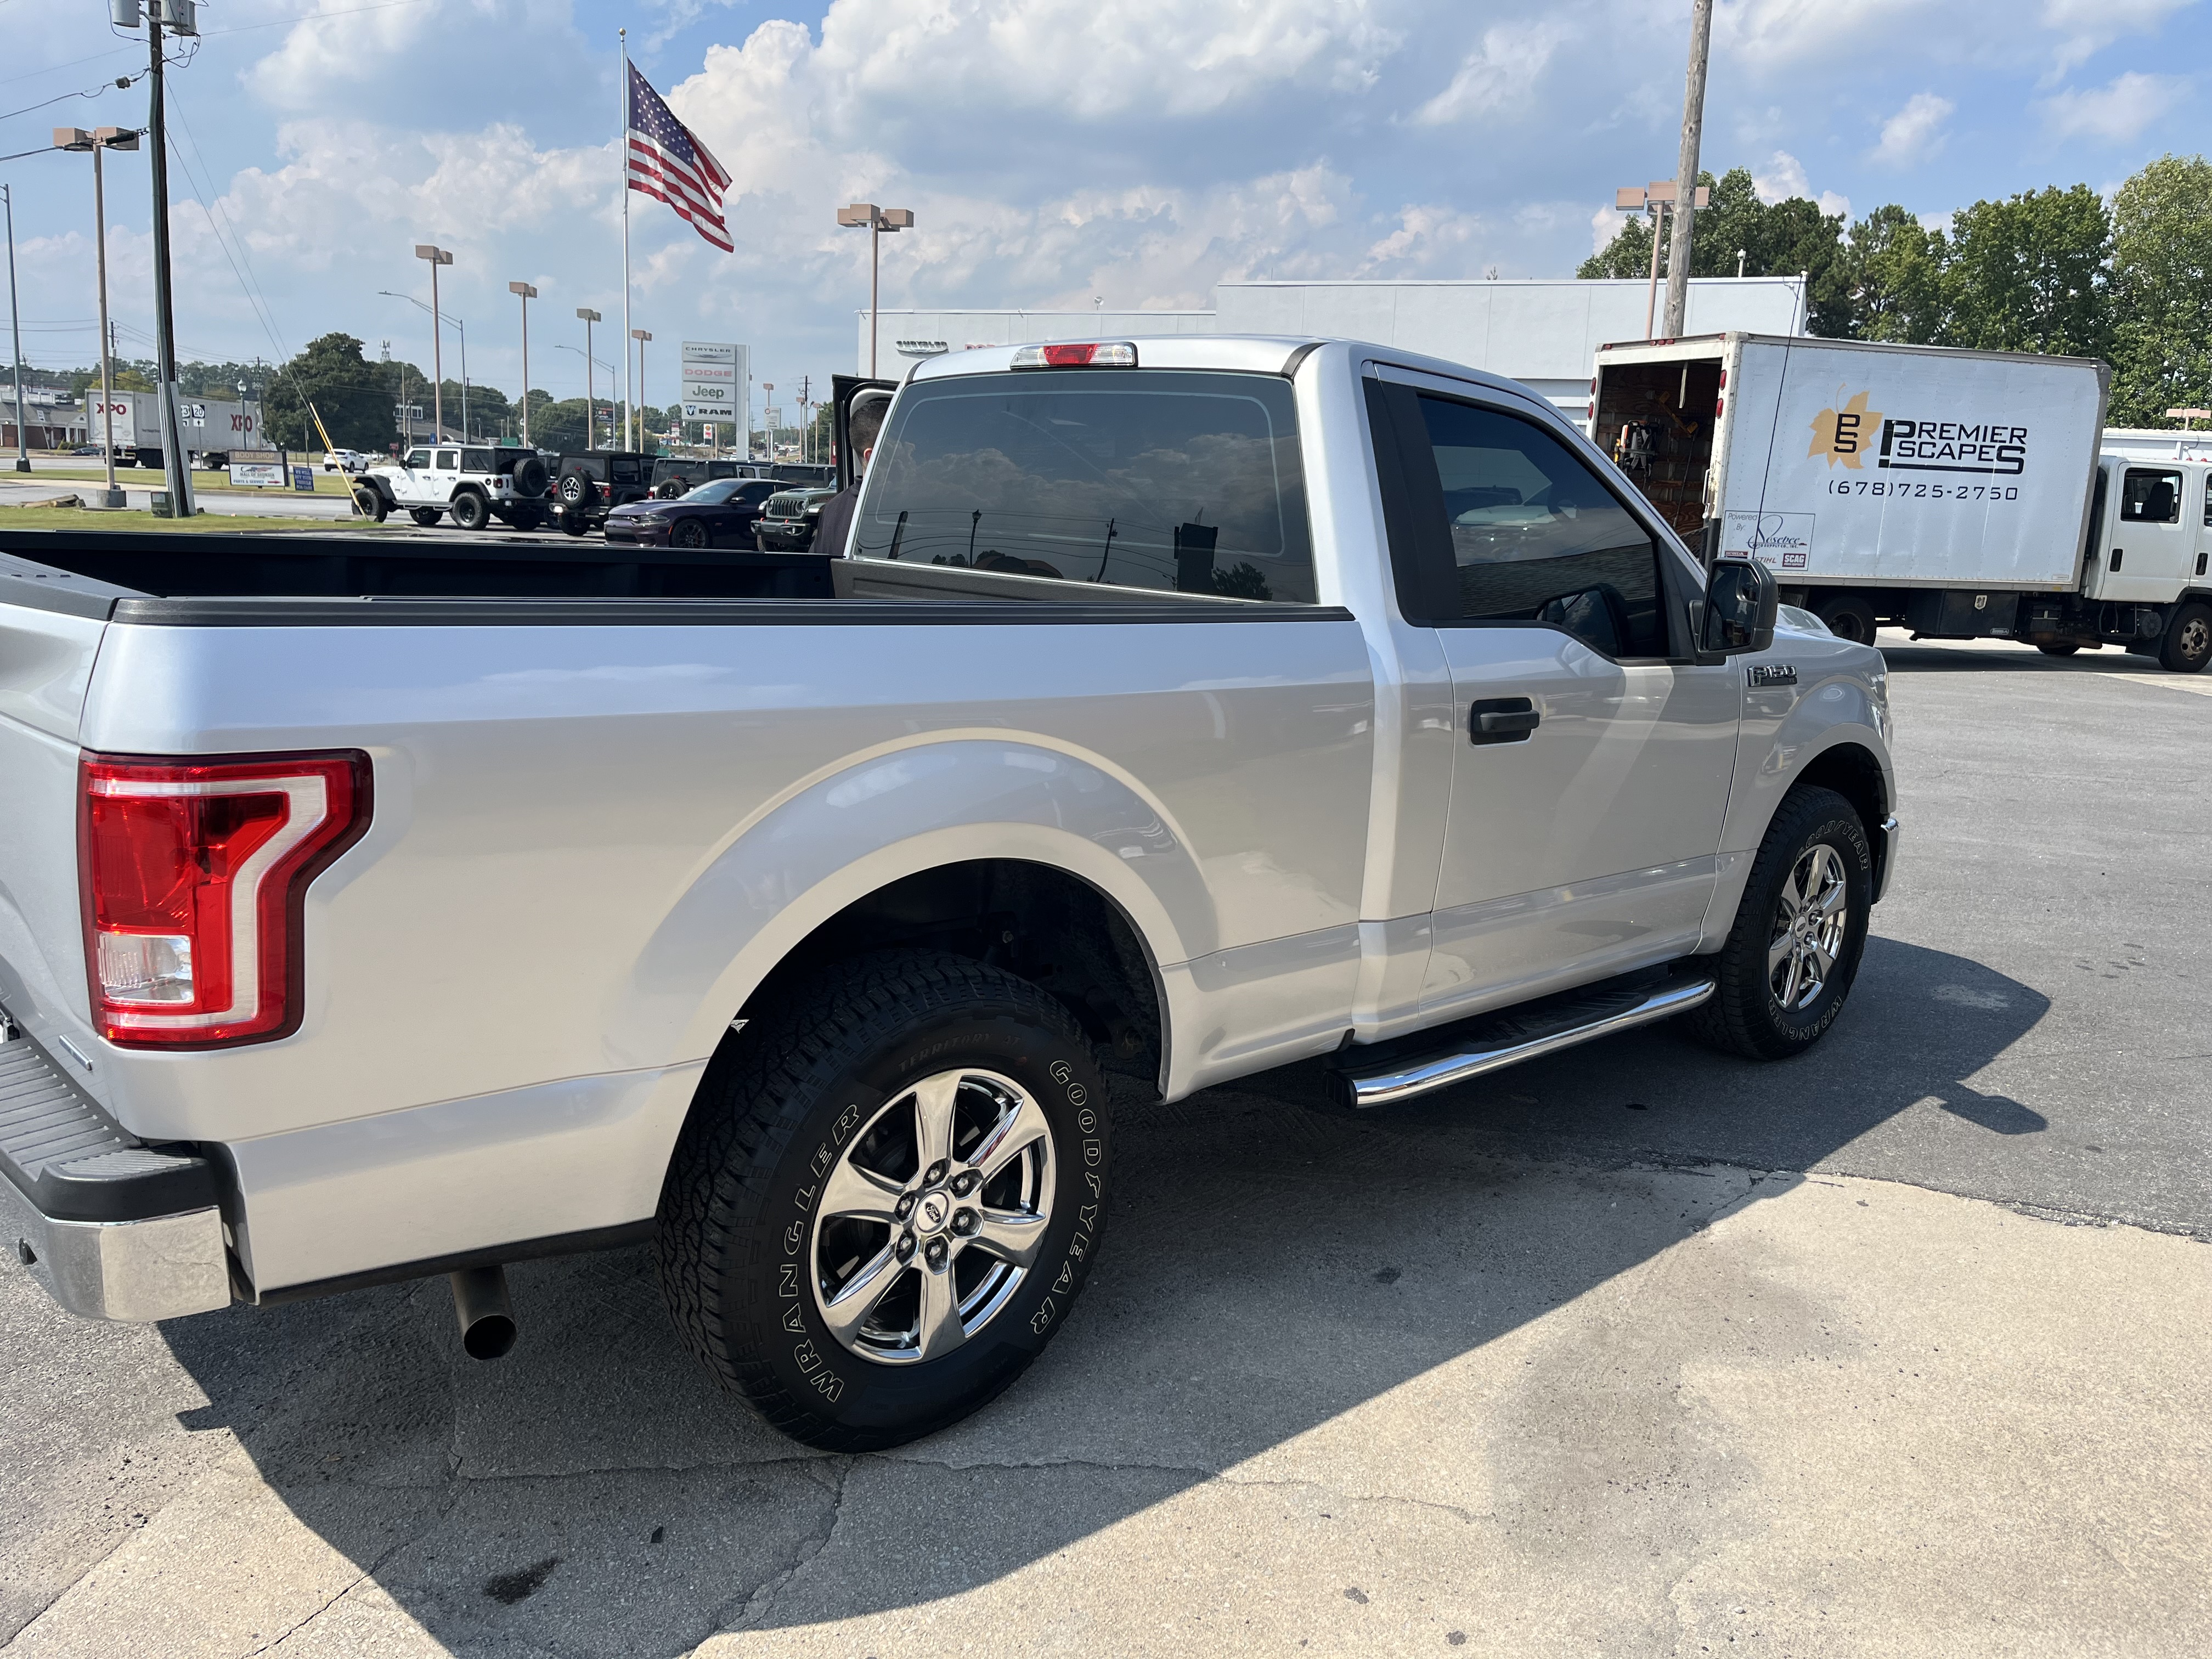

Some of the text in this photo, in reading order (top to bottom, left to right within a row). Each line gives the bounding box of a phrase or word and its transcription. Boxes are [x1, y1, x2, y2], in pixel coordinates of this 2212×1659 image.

[684, 369, 732, 377] DODGE
[692, 385, 724, 399] Jeep
[1880, 419, 2027, 455] PREMIER
[1897, 441, 2026, 475] SCAPES
[1829, 480, 2018, 500] (678)725-2750
[1728, 512, 1758, 521] Powered
[1784, 555, 1804, 563] SCAG
[1796, 820, 1869, 871] GOODYEAR
[1768, 995, 1843, 1041] WRANGLER
[898, 1032, 992, 1073] TERRITORY
[926, 1204, 940, 1222] Ford
[1031, 1060, 1102, 1335] GOODYEAR
[779, 1104, 860, 1403] WRANGLER
